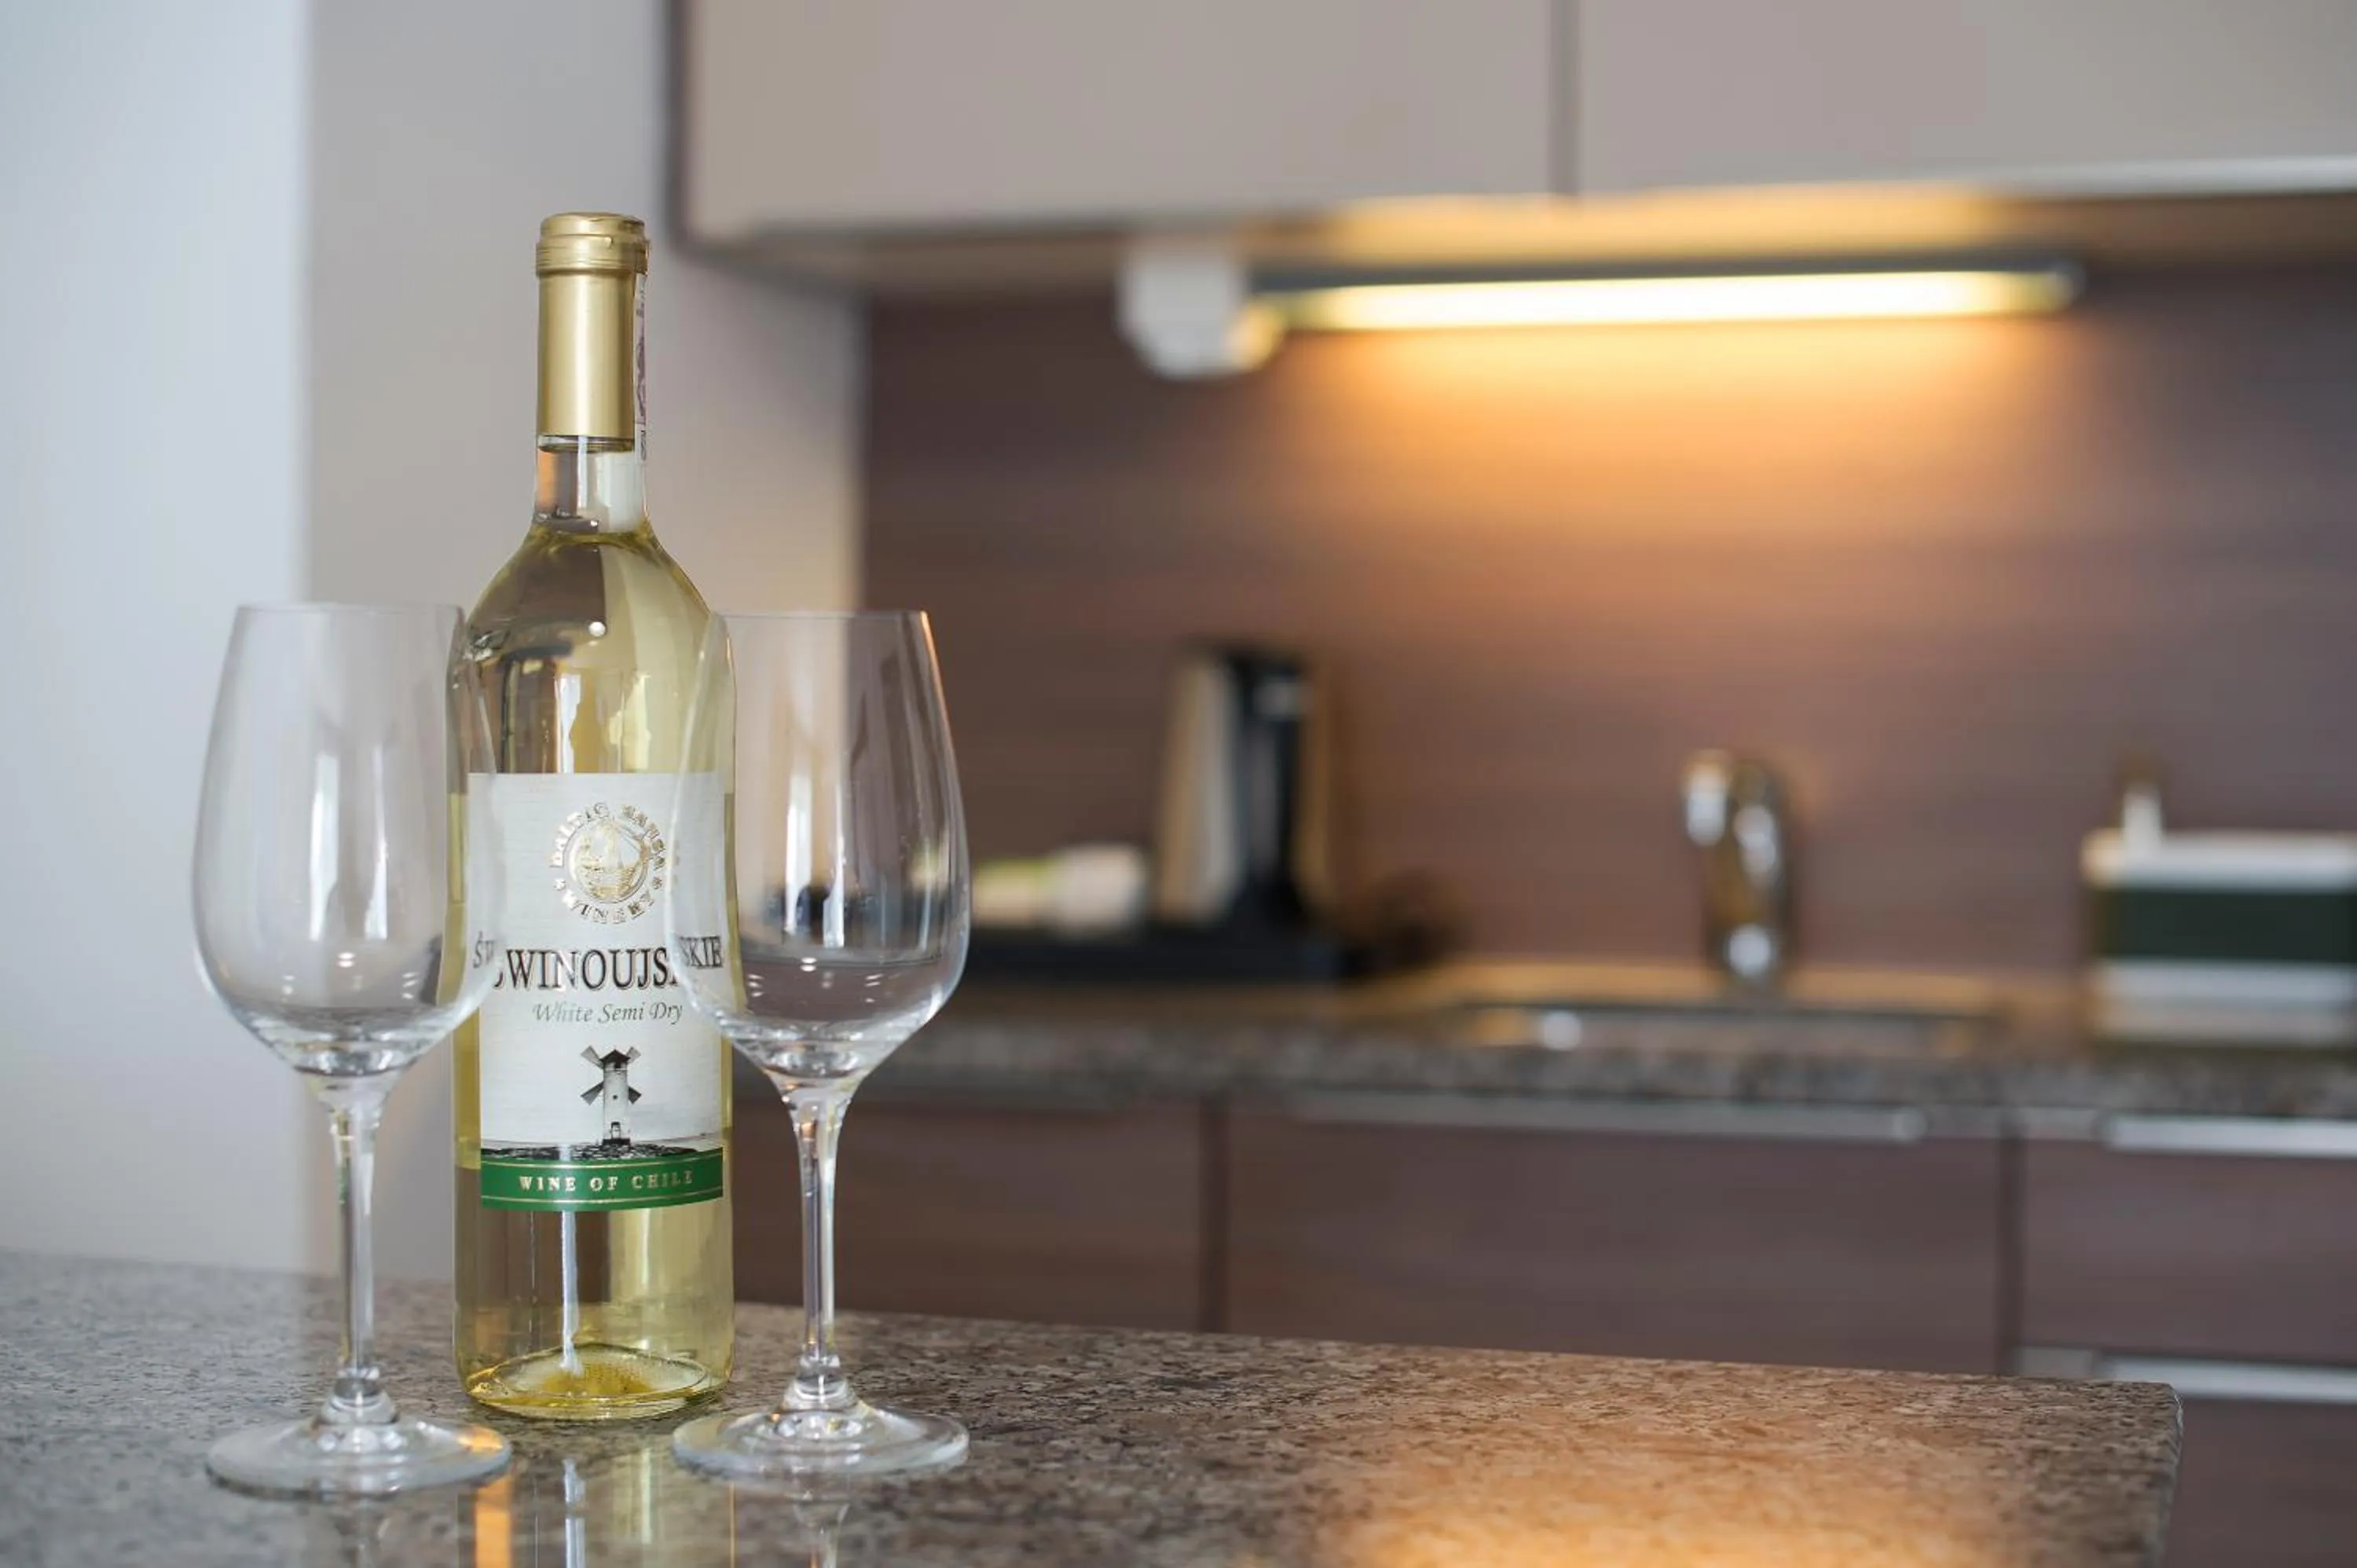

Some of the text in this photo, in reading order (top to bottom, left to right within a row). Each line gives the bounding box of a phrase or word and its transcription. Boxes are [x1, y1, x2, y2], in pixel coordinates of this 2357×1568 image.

[532, 1000, 683, 1025] White Semi Dry
[519, 1170, 694, 1192] WINE OF CHILE
